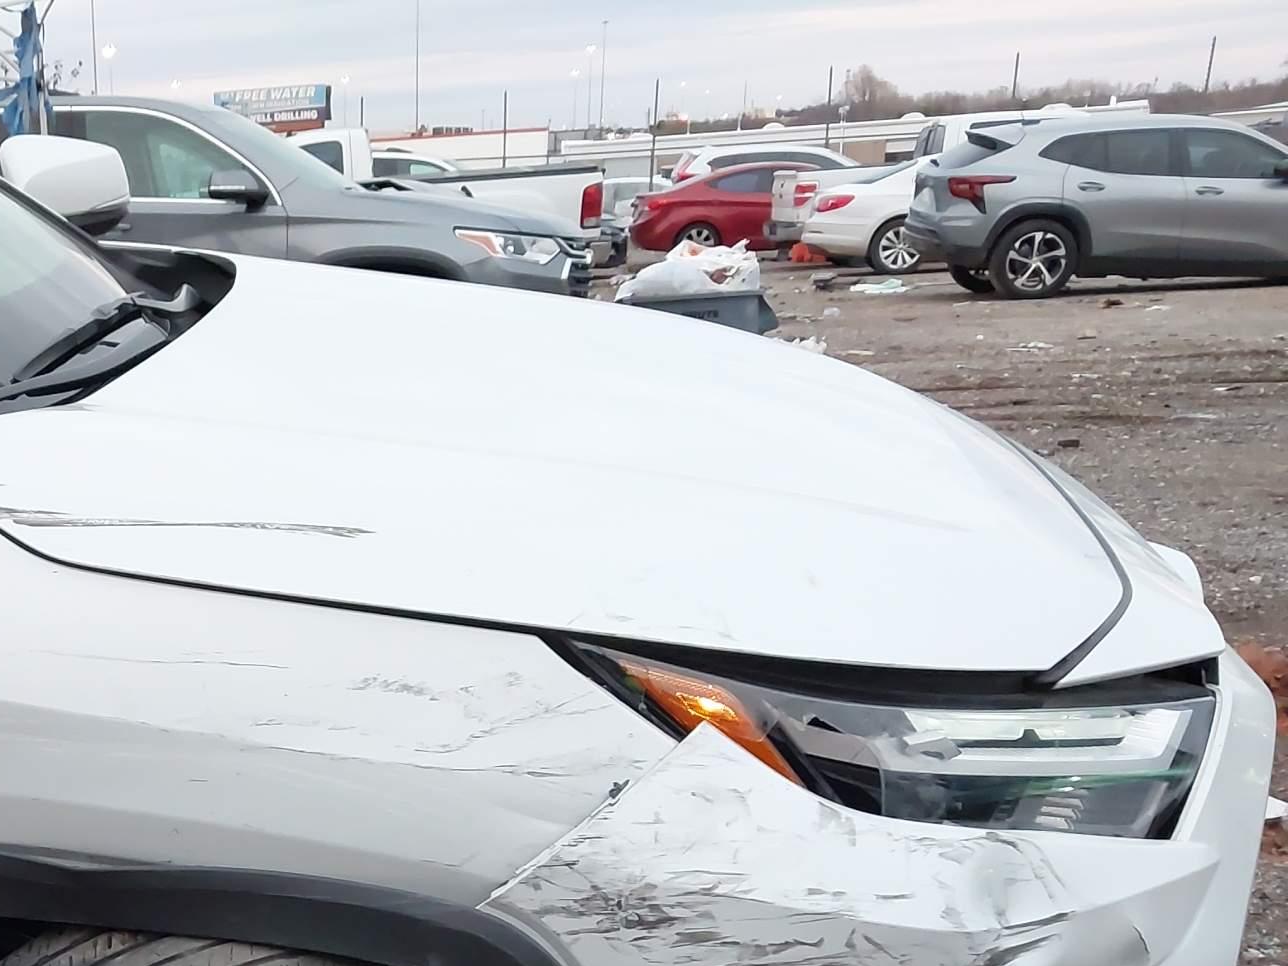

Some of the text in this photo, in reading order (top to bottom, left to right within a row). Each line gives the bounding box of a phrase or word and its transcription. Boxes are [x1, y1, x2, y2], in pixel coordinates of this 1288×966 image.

[235, 88, 268, 102] FREE
[270, 86, 315, 99] WATER
[274, 110, 318, 121] DRILLING
